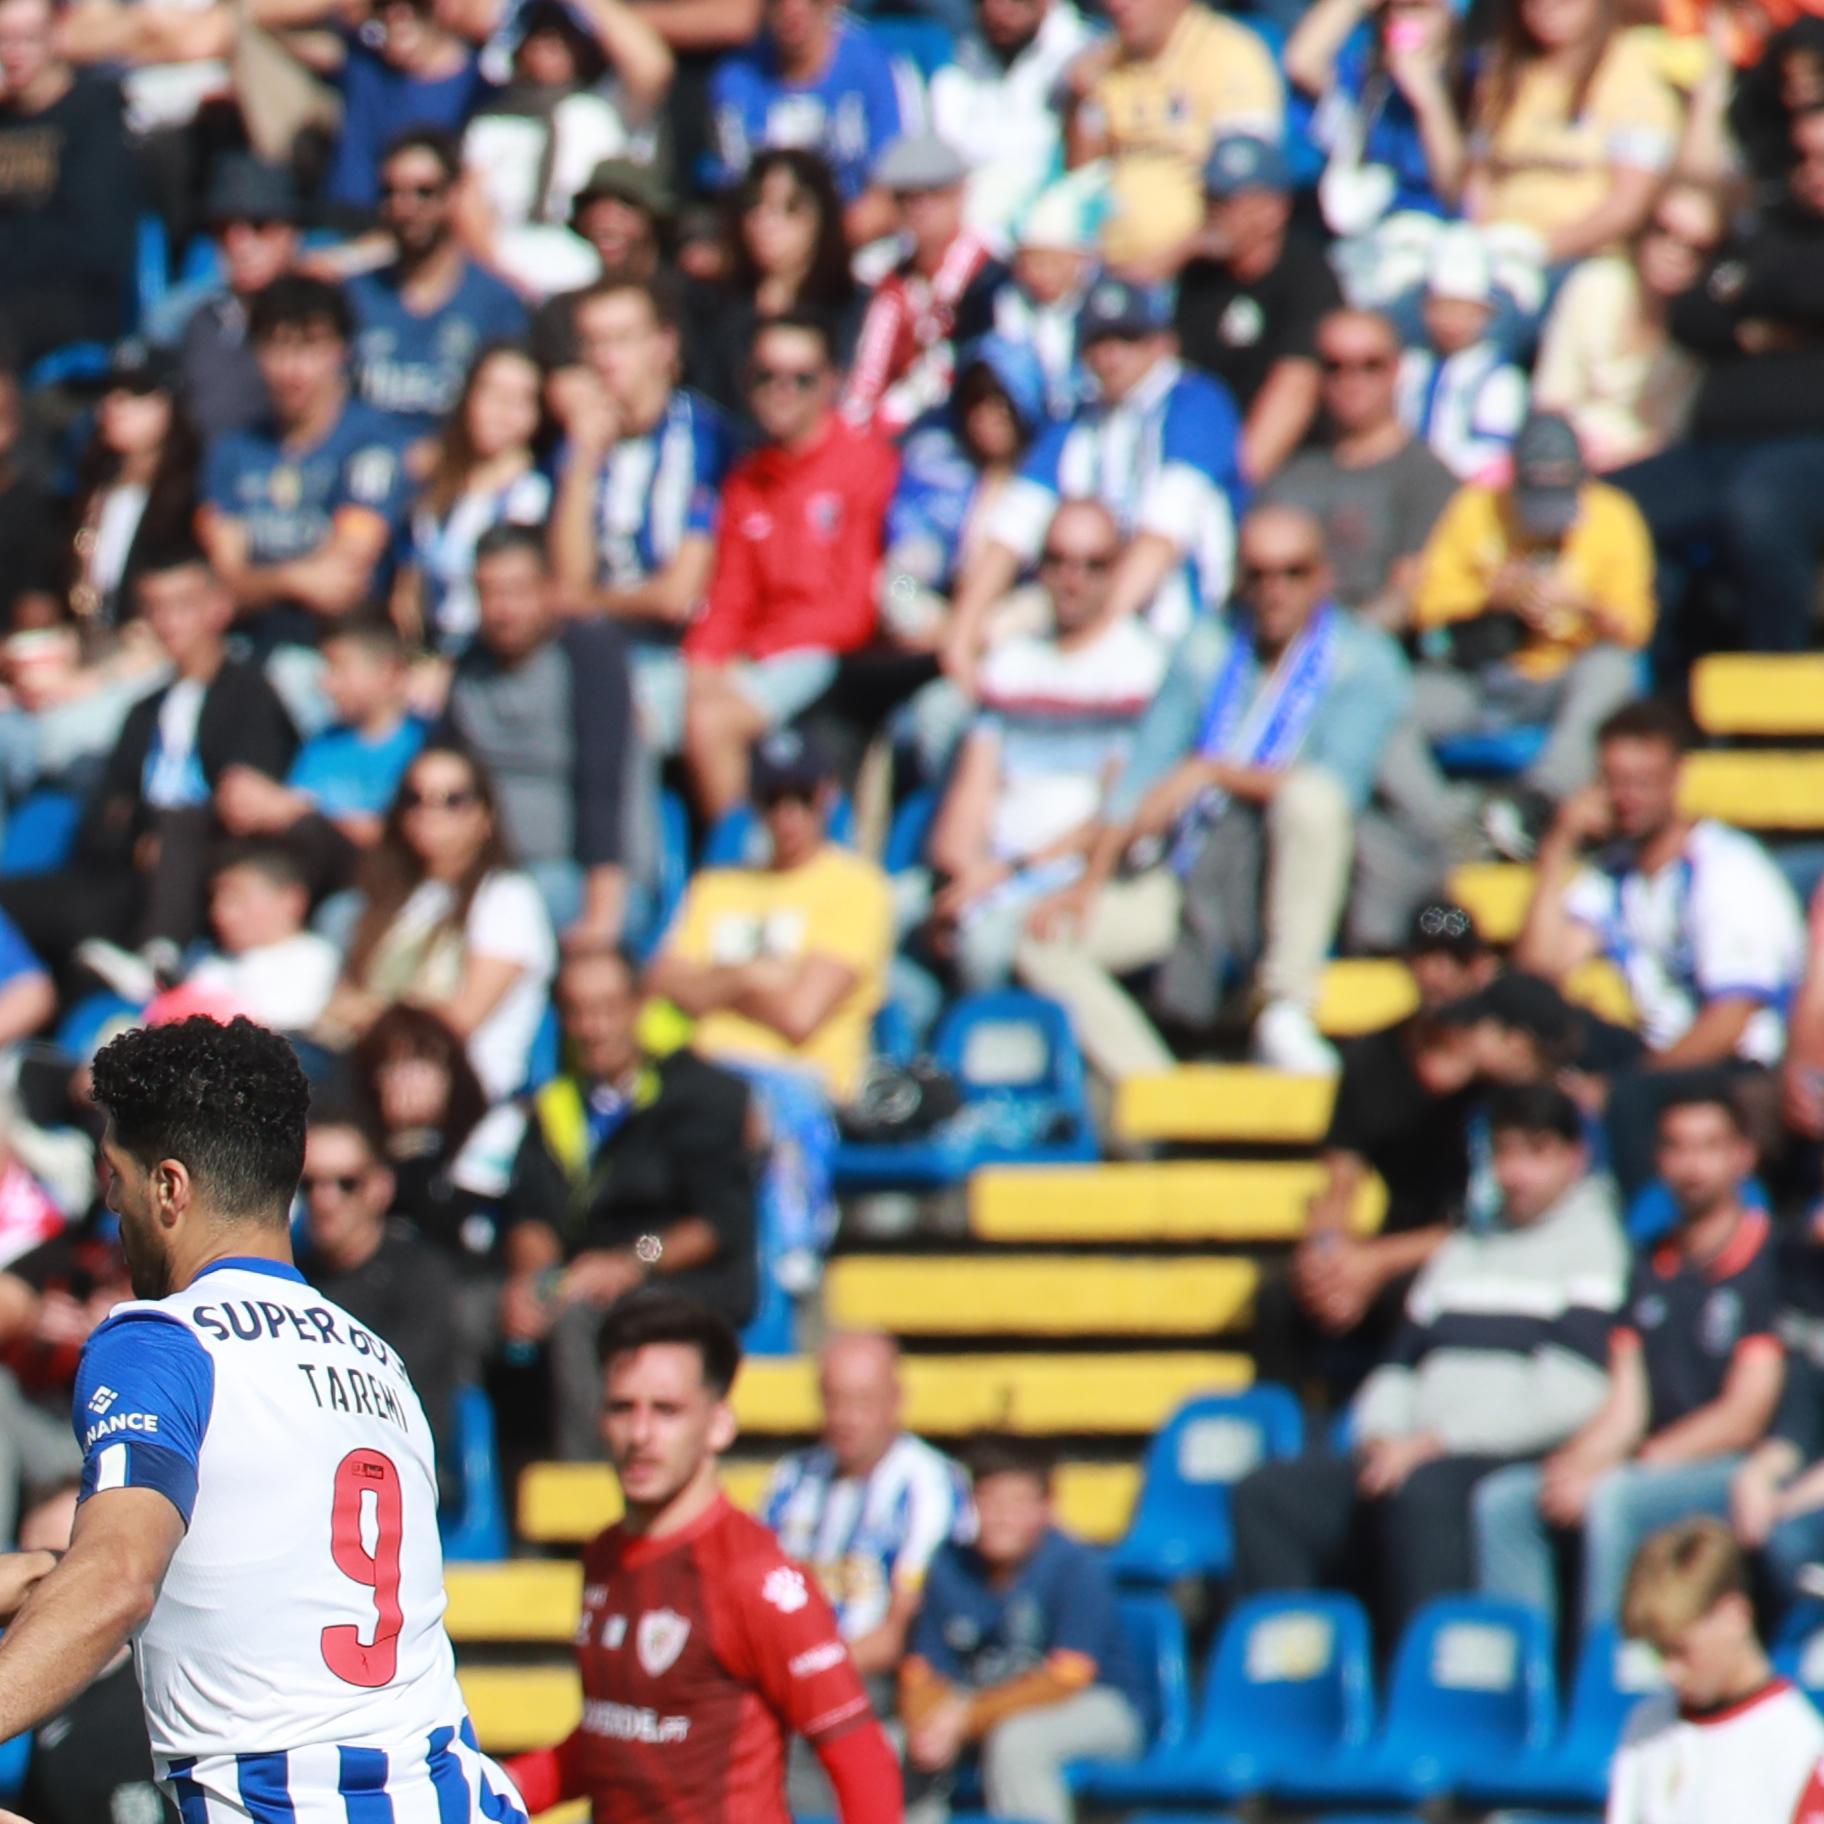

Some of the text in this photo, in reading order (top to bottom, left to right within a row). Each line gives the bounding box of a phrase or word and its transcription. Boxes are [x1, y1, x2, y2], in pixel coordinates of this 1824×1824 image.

[193, 1300, 346, 1345] SUPER
[297, 1363, 408, 1434] TAREMI
[85, 1412, 159, 1447] NANCE
[321, 1447, 404, 1688] 9
